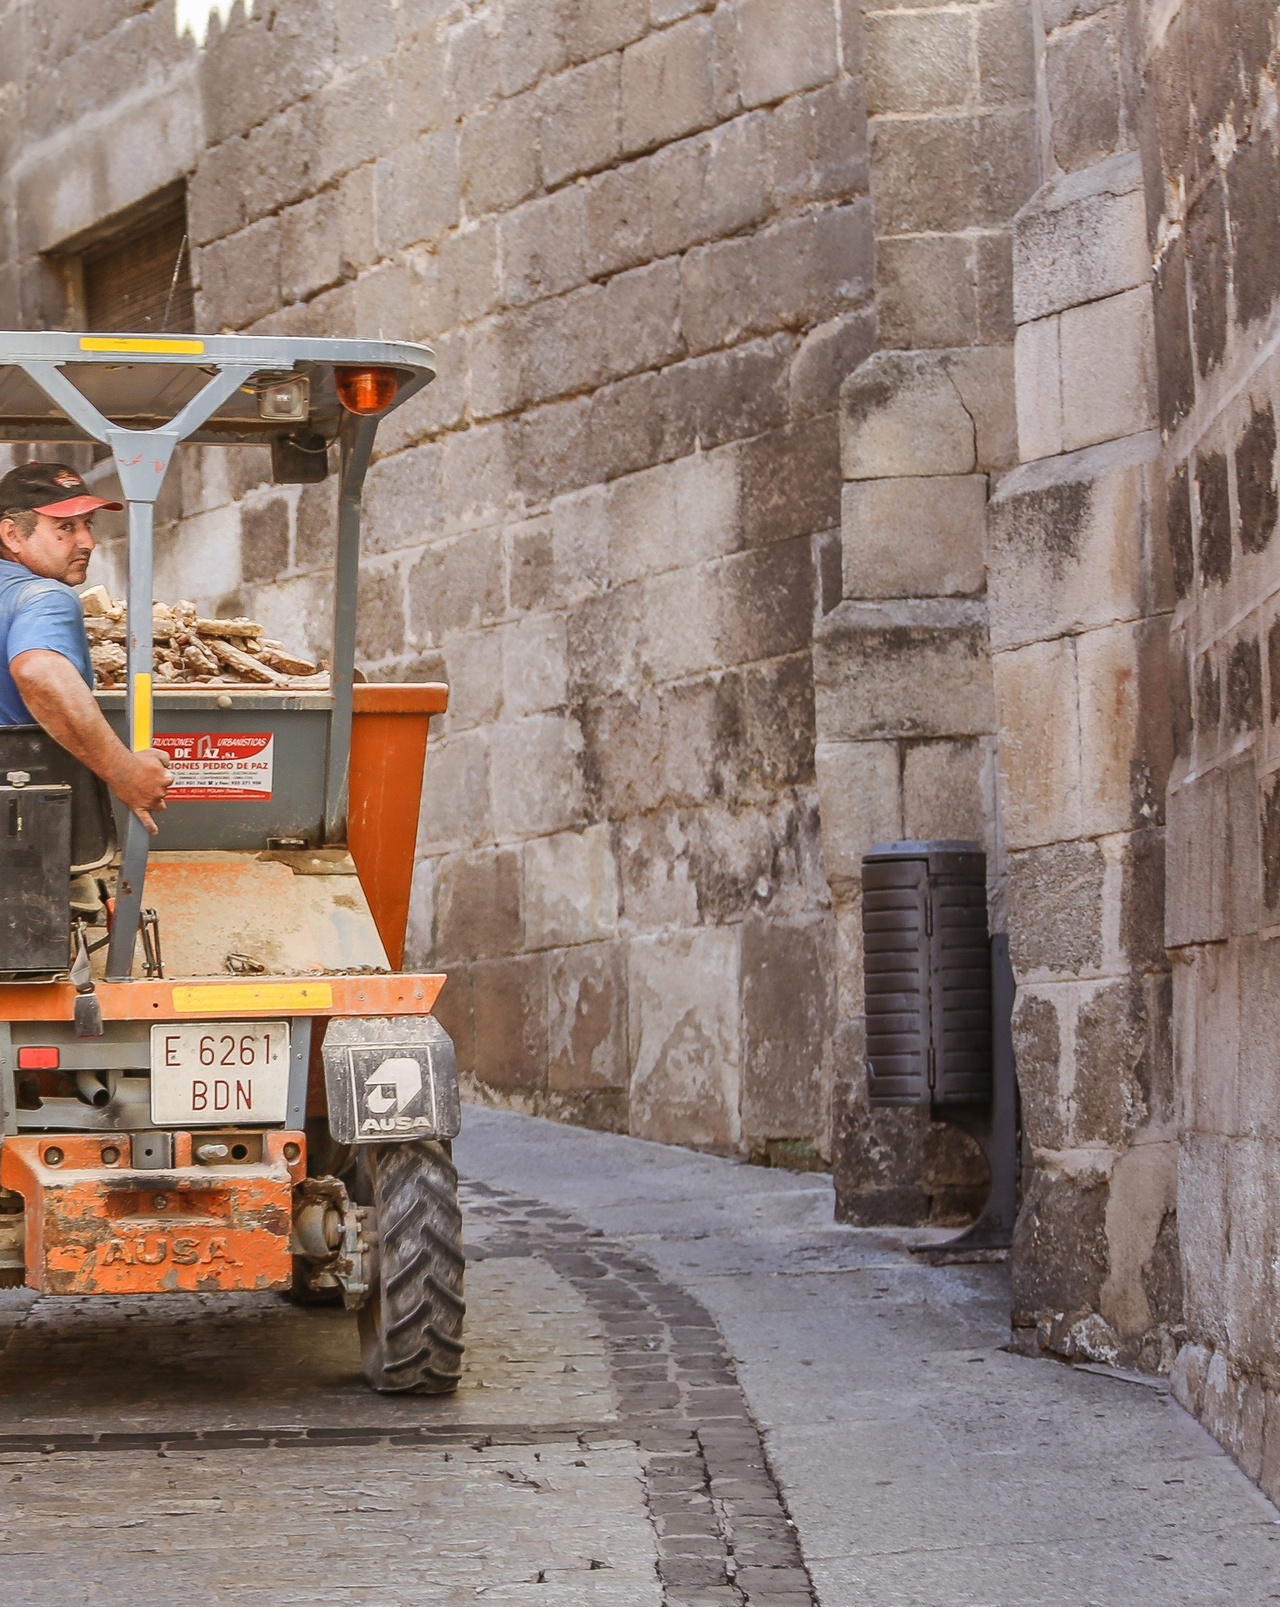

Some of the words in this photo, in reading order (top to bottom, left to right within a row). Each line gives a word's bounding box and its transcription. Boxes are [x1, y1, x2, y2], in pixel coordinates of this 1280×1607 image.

[203, 762, 233, 770] PEDRO
[237, 762, 248, 770] DE
[251, 762, 268, 770] PAZ
[165, 1036, 181, 1066] E
[200, 1034, 270, 1066] 6261
[192, 1080, 252, 1111] BDN
[361, 1116, 431, 1131] AUSA
[101, 1237, 236, 1266] AUSA
